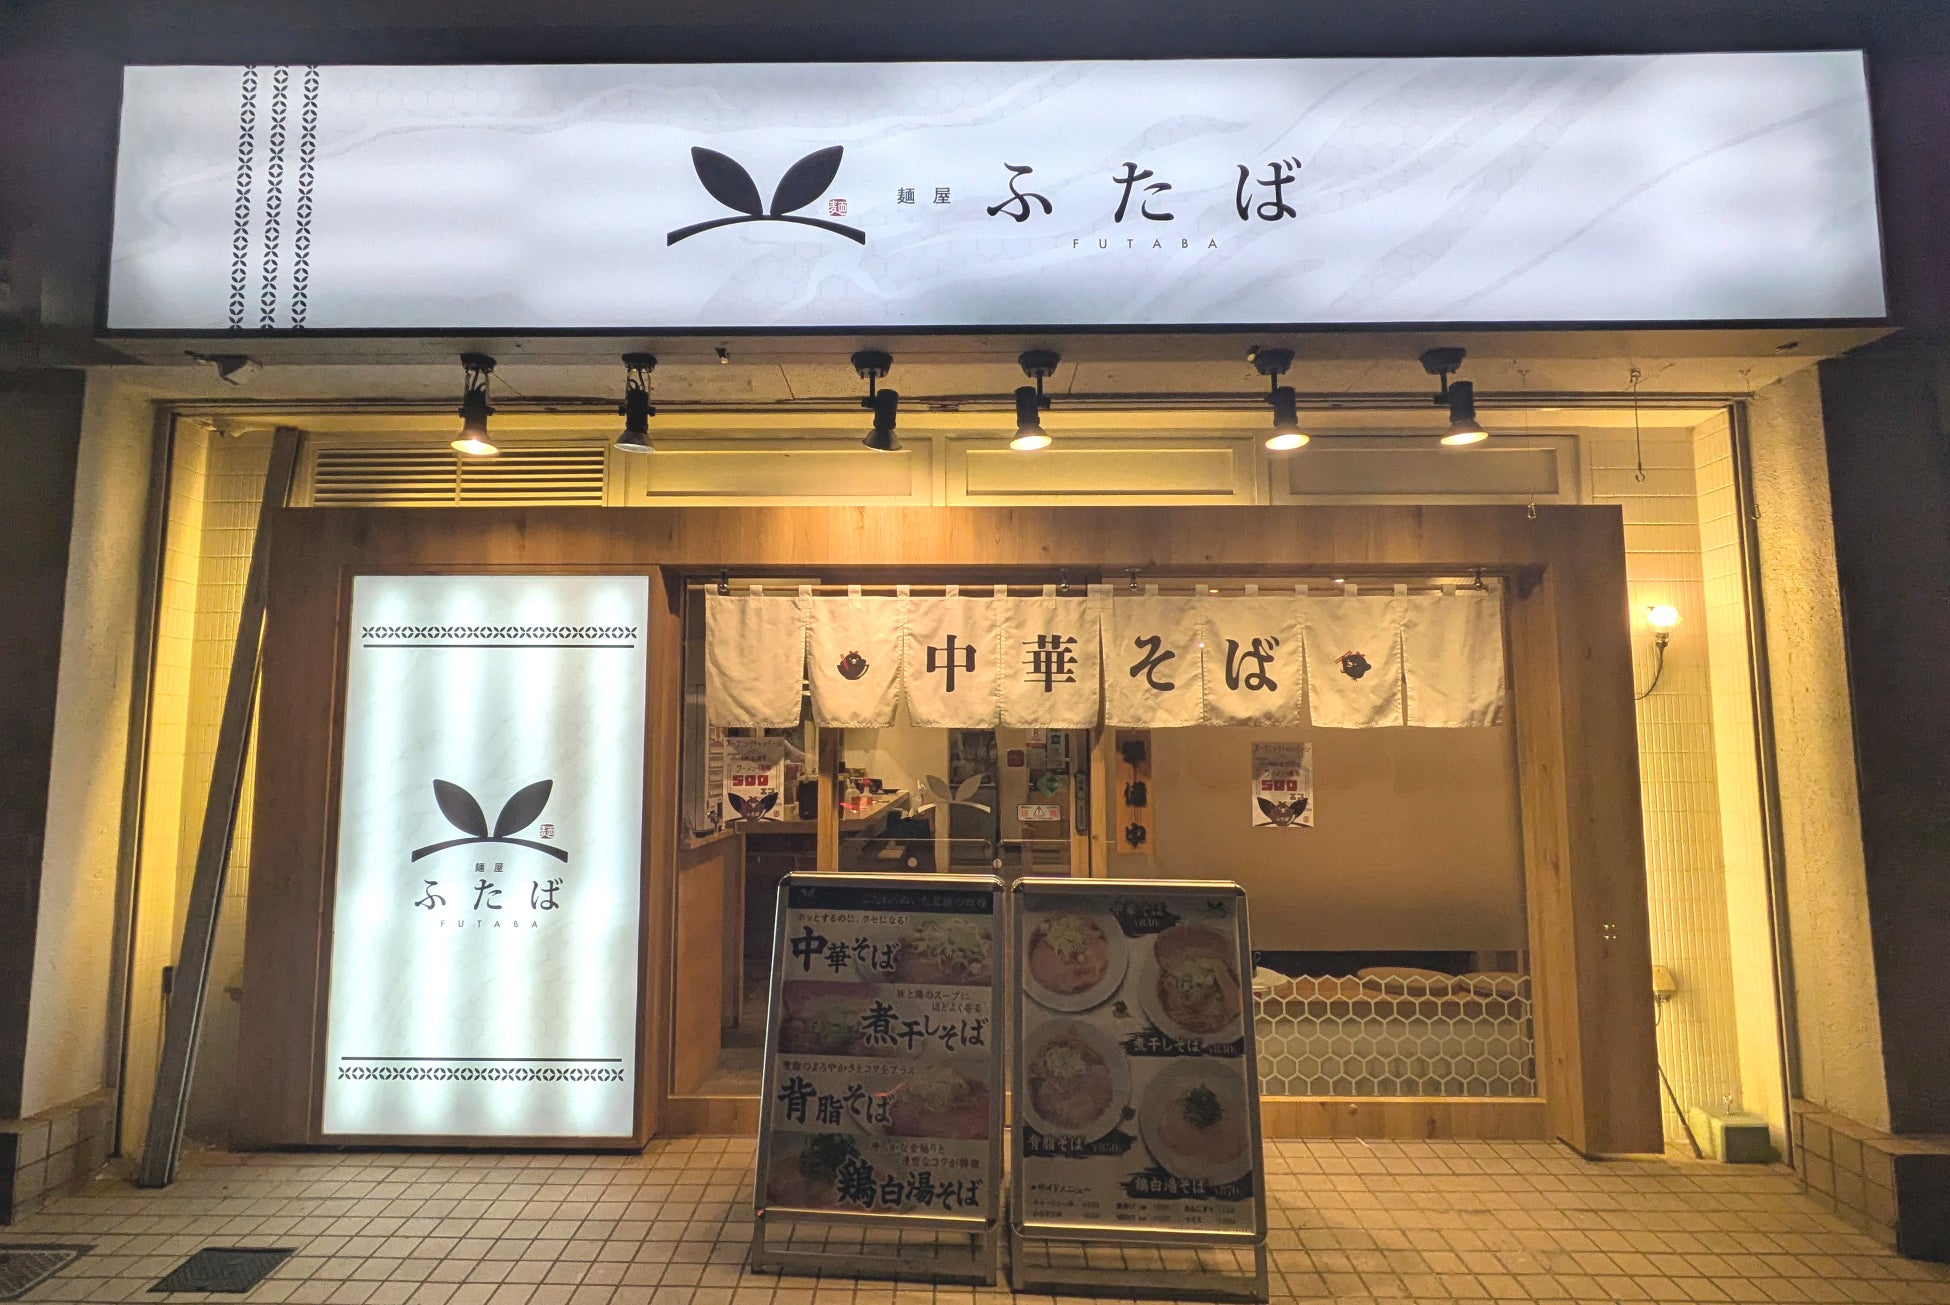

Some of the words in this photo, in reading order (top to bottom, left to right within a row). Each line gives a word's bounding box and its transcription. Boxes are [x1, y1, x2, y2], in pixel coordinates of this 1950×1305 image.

[897, 187, 952, 205] 麺屋
[986, 156, 1302, 223] ふたば
[1072, 238, 1218, 249] FUTABA
[926, 634, 1280, 693] 中華そば
[733, 775, 768, 787] 500
[1261, 779, 1298, 792] 500
[475, 862, 504, 873] 麺屋
[415, 878, 564, 911] ふたば
[440, 919, 540, 929] FUTABA
[790, 926, 900, 973] 中華そば
[860, 1001, 989, 1051] 煮干しそば
[777, 1076, 896, 1126] 背脂そば
[837, 1157, 983, 1211] 鶏白湯そば
